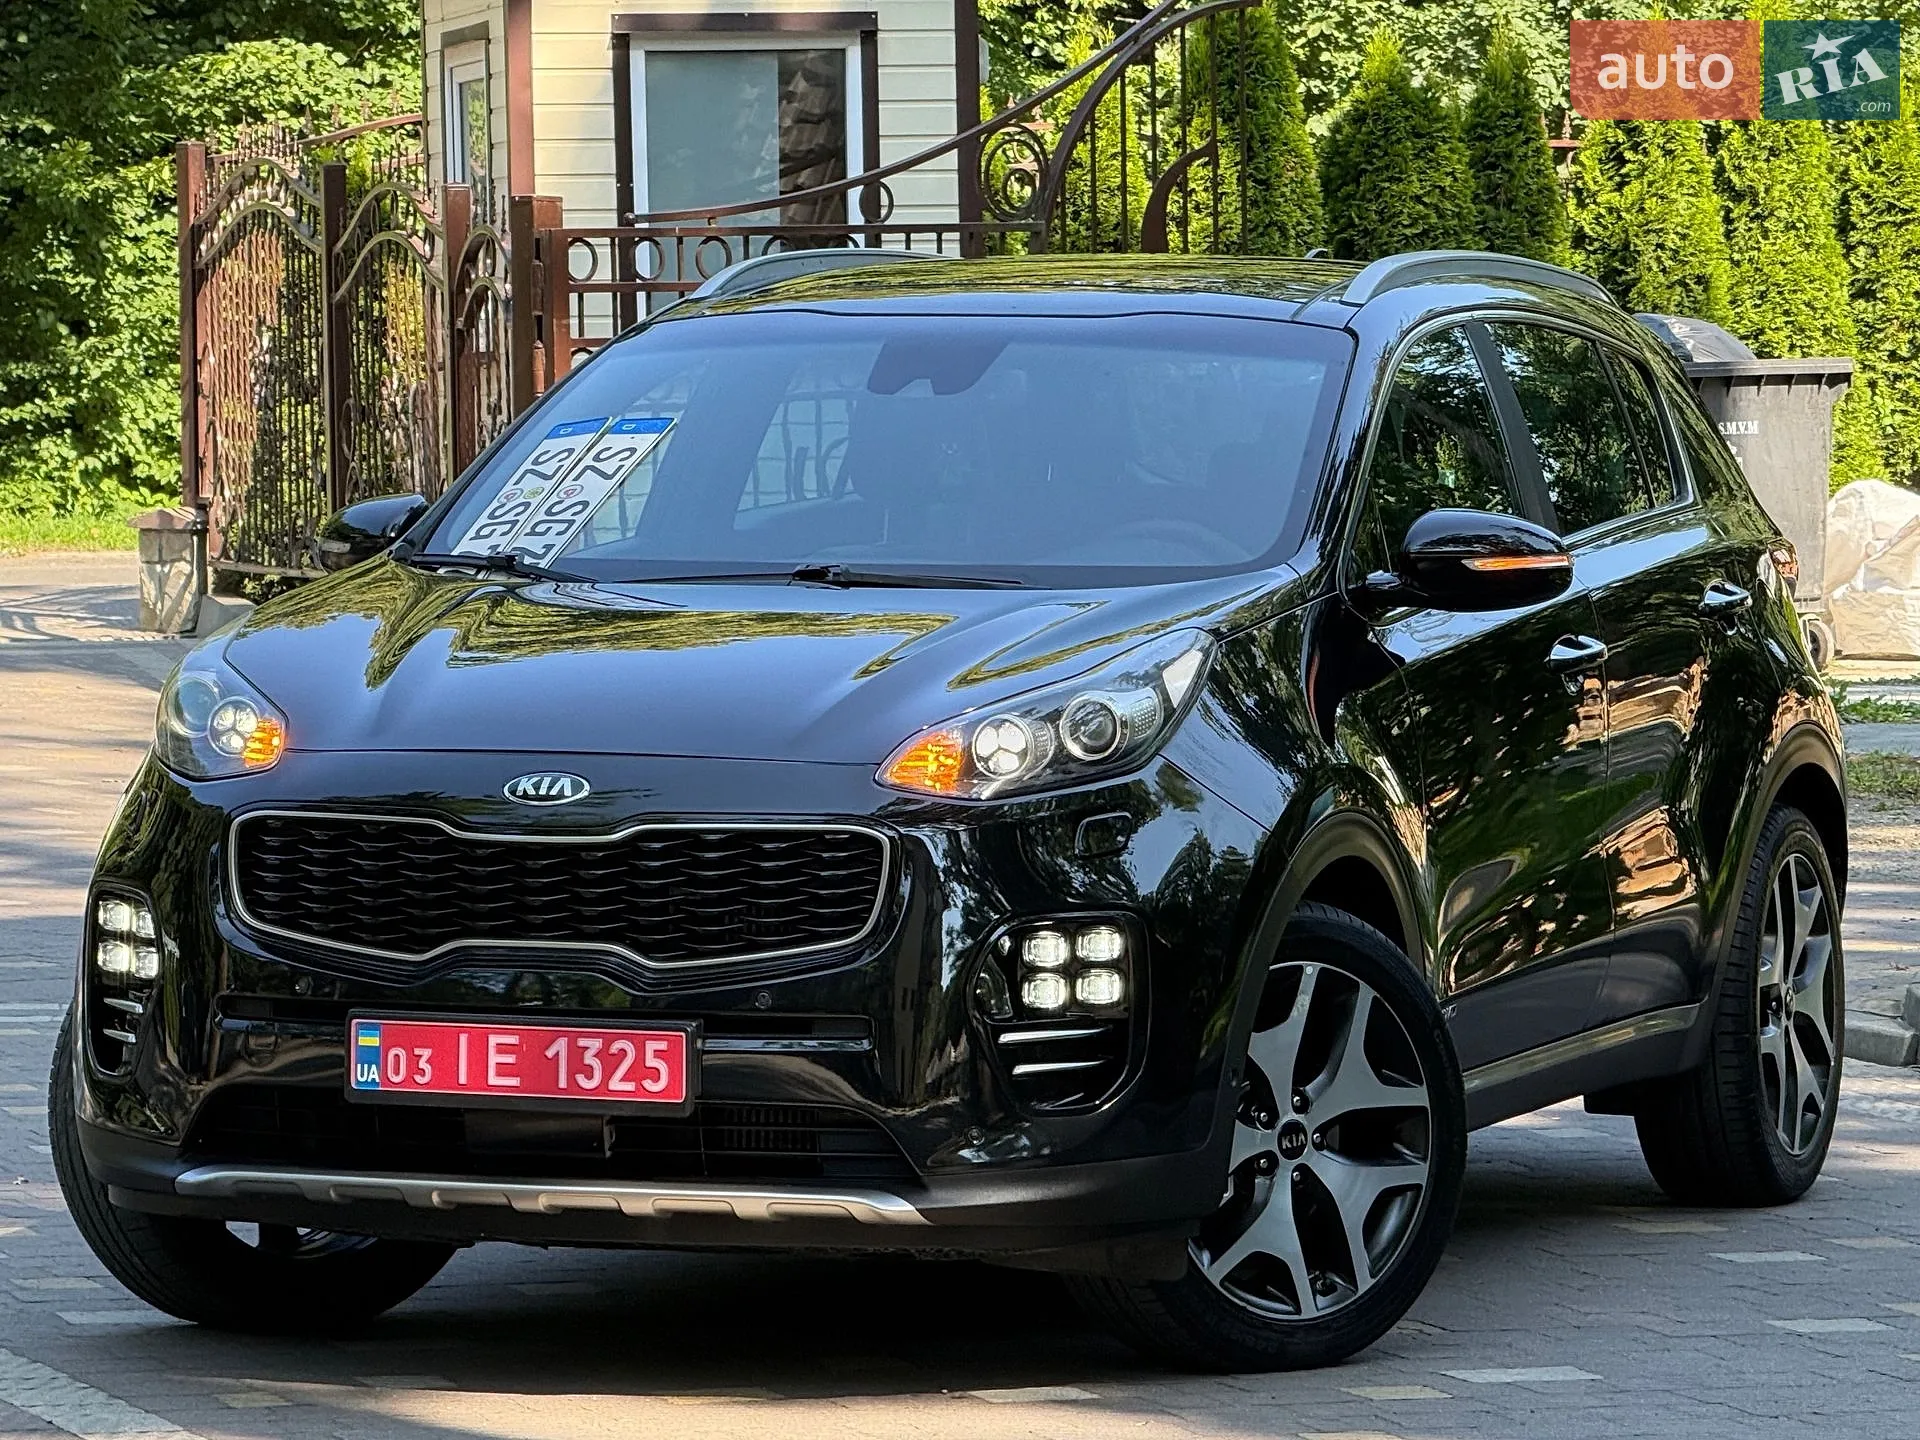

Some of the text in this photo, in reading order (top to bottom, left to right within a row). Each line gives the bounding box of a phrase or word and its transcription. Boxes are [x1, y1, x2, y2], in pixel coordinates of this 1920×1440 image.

[513, 447, 576, 486] SZ
[573, 446, 638, 481] SZ
[524, 499, 590, 537] SG
[515, 776, 572, 797] KIA
[357, 1063, 380, 1084] UA
[386, 1032, 670, 1094] 03 IE 1325
[1281, 1132, 1306, 1149] KIA
